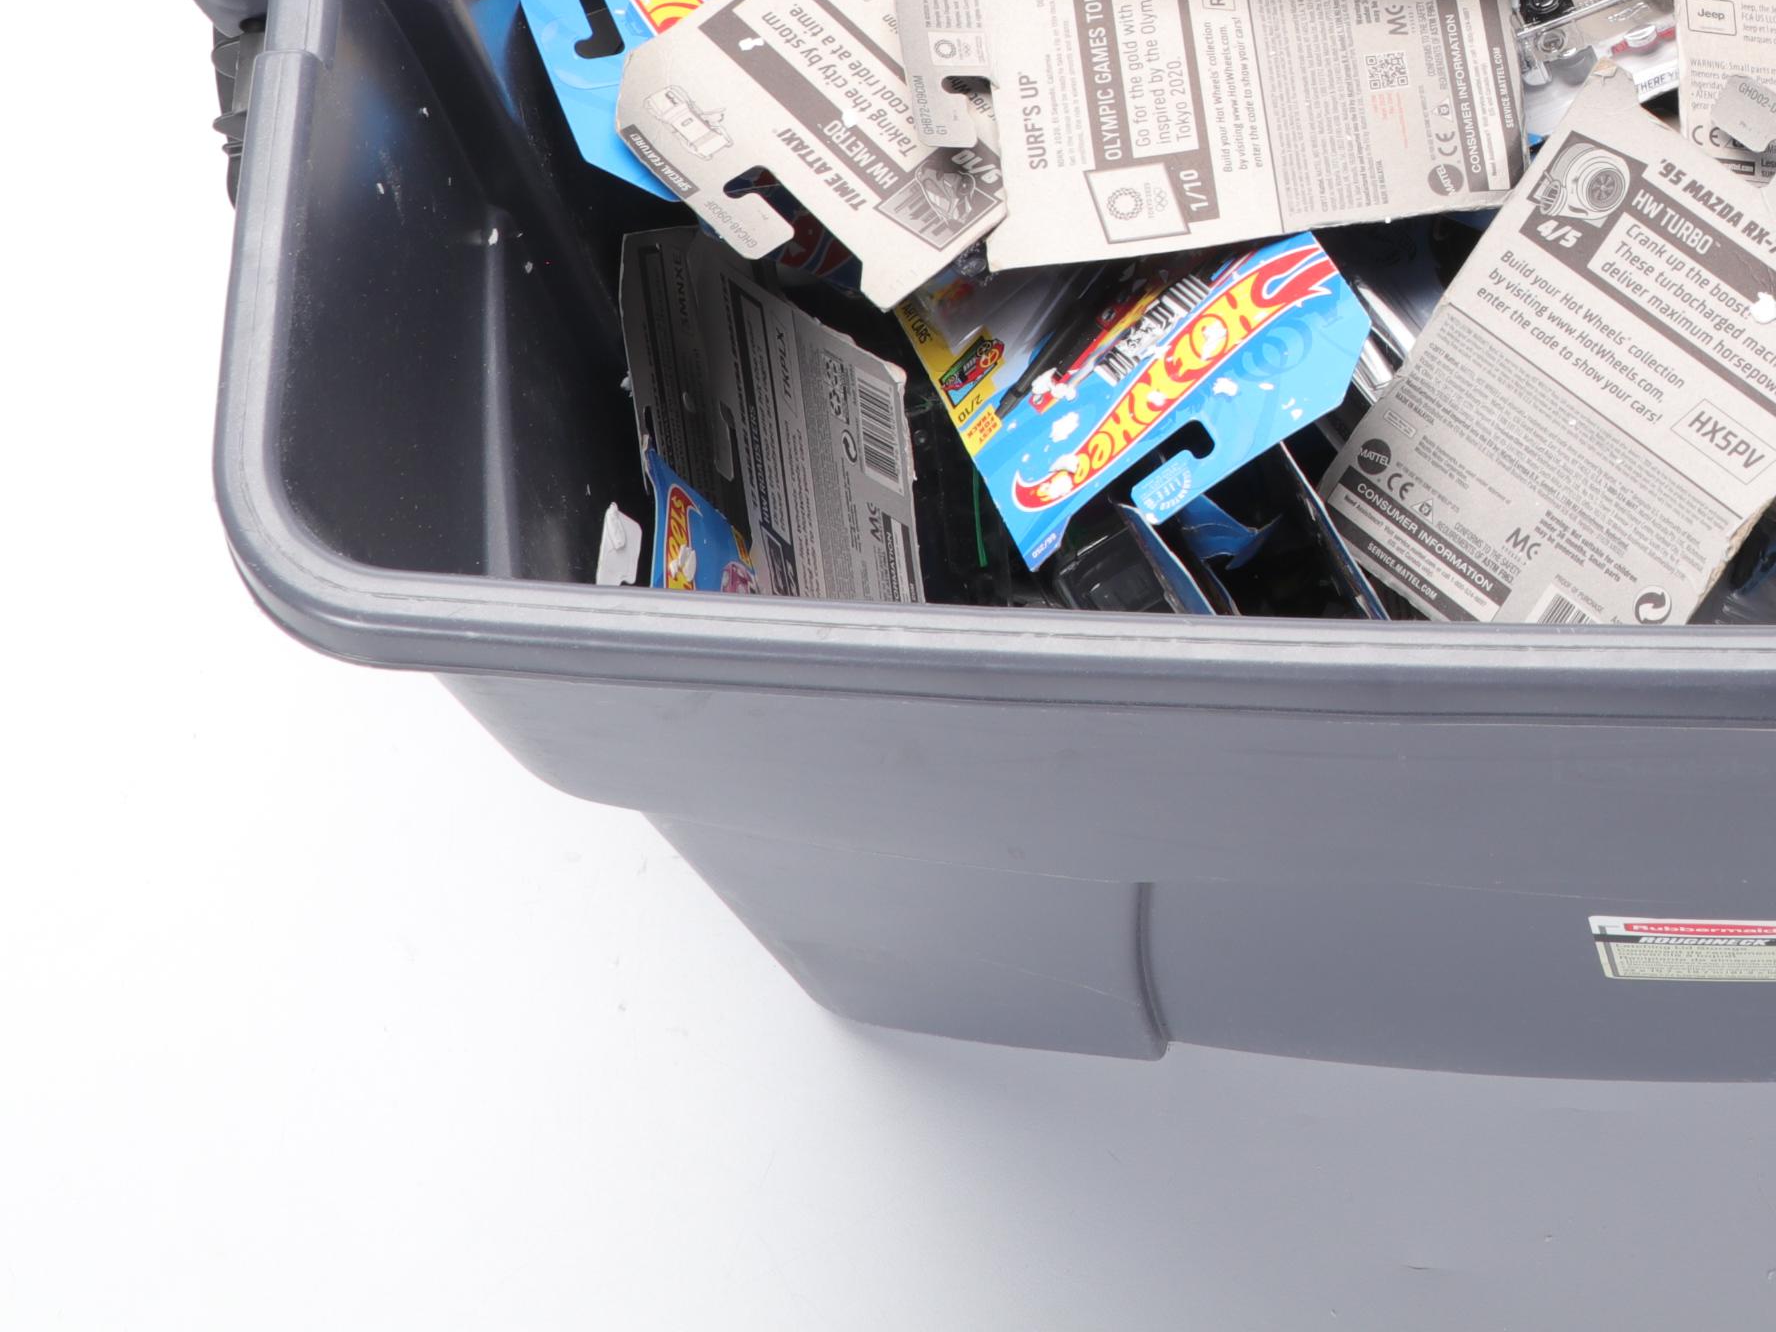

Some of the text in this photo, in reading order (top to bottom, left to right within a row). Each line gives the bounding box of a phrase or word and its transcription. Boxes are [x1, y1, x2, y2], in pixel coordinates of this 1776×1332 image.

[1116, 4, 1135, 36] with
[1697, 7, 1725, 20] Jeep
[784, 1, 909, 119] cool ride at a time.
[1089, 25, 1112, 84] GAMES
[1122, 41, 1143, 71] gold
[1143, 39, 1158, 62] the
[1147, 66, 1165, 84] by
[760, 9, 920, 157] Taking the city by storm
[1127, 75, 1144, 100] the
[1131, 103, 1147, 124] for
[1165, 55, 1194, 141] Tokyo 2020.
[1445, 13, 1481, 173] CONSUMER INFORMATION
[1018, 72, 1048, 170] SURF'S UP
[1096, 88, 1122, 160] OLYMPIC
[1134, 128, 1151, 147] Go
[1149, 88, 1172, 145] inspired
[627, 130, 692, 193] SPECIAL FEATURE!
[775, 124, 867, 212] TIME ATTAXI
[823, 117, 899, 190] HW METRO
[1180, 168, 1209, 212] 1/10
[1654, 157, 1687, 187] '95
[1681, 177, 1745, 229] MAZDA
[1534, 211, 1581, 254] 4/5
[1631, 188, 1715, 256] HW TURBO
[1487, 267, 1507, 287] by
[1502, 278, 1550, 318] visiting
[1599, 258, 1650, 300] deliver
[1646, 293, 1715, 347] maximum
[1612, 240, 1657, 278] These
[1651, 269, 1746, 343] turbocharged
[1624, 222, 1755, 321] Crank up the boost!
[911, 320, 932, 344] CARS
[1499, 249, 1537, 281] Build
[1530, 275, 1561, 302] your
[1558, 292, 1585, 316] Hot
[1626, 340, 1688, 390] collection
[1475, 286, 1663, 425] enter the code to show your cars!
[1358, 443, 1392, 473] MATTEL
[1686, 409, 1765, 474] HX5PV
[1353, 481, 1496, 591] CONSUMER INFORMATION
[1366, 540, 1438, 603] SERVICE.MATTEL.COM
[1639, 936, 1769, 946] ROUGHNECK
